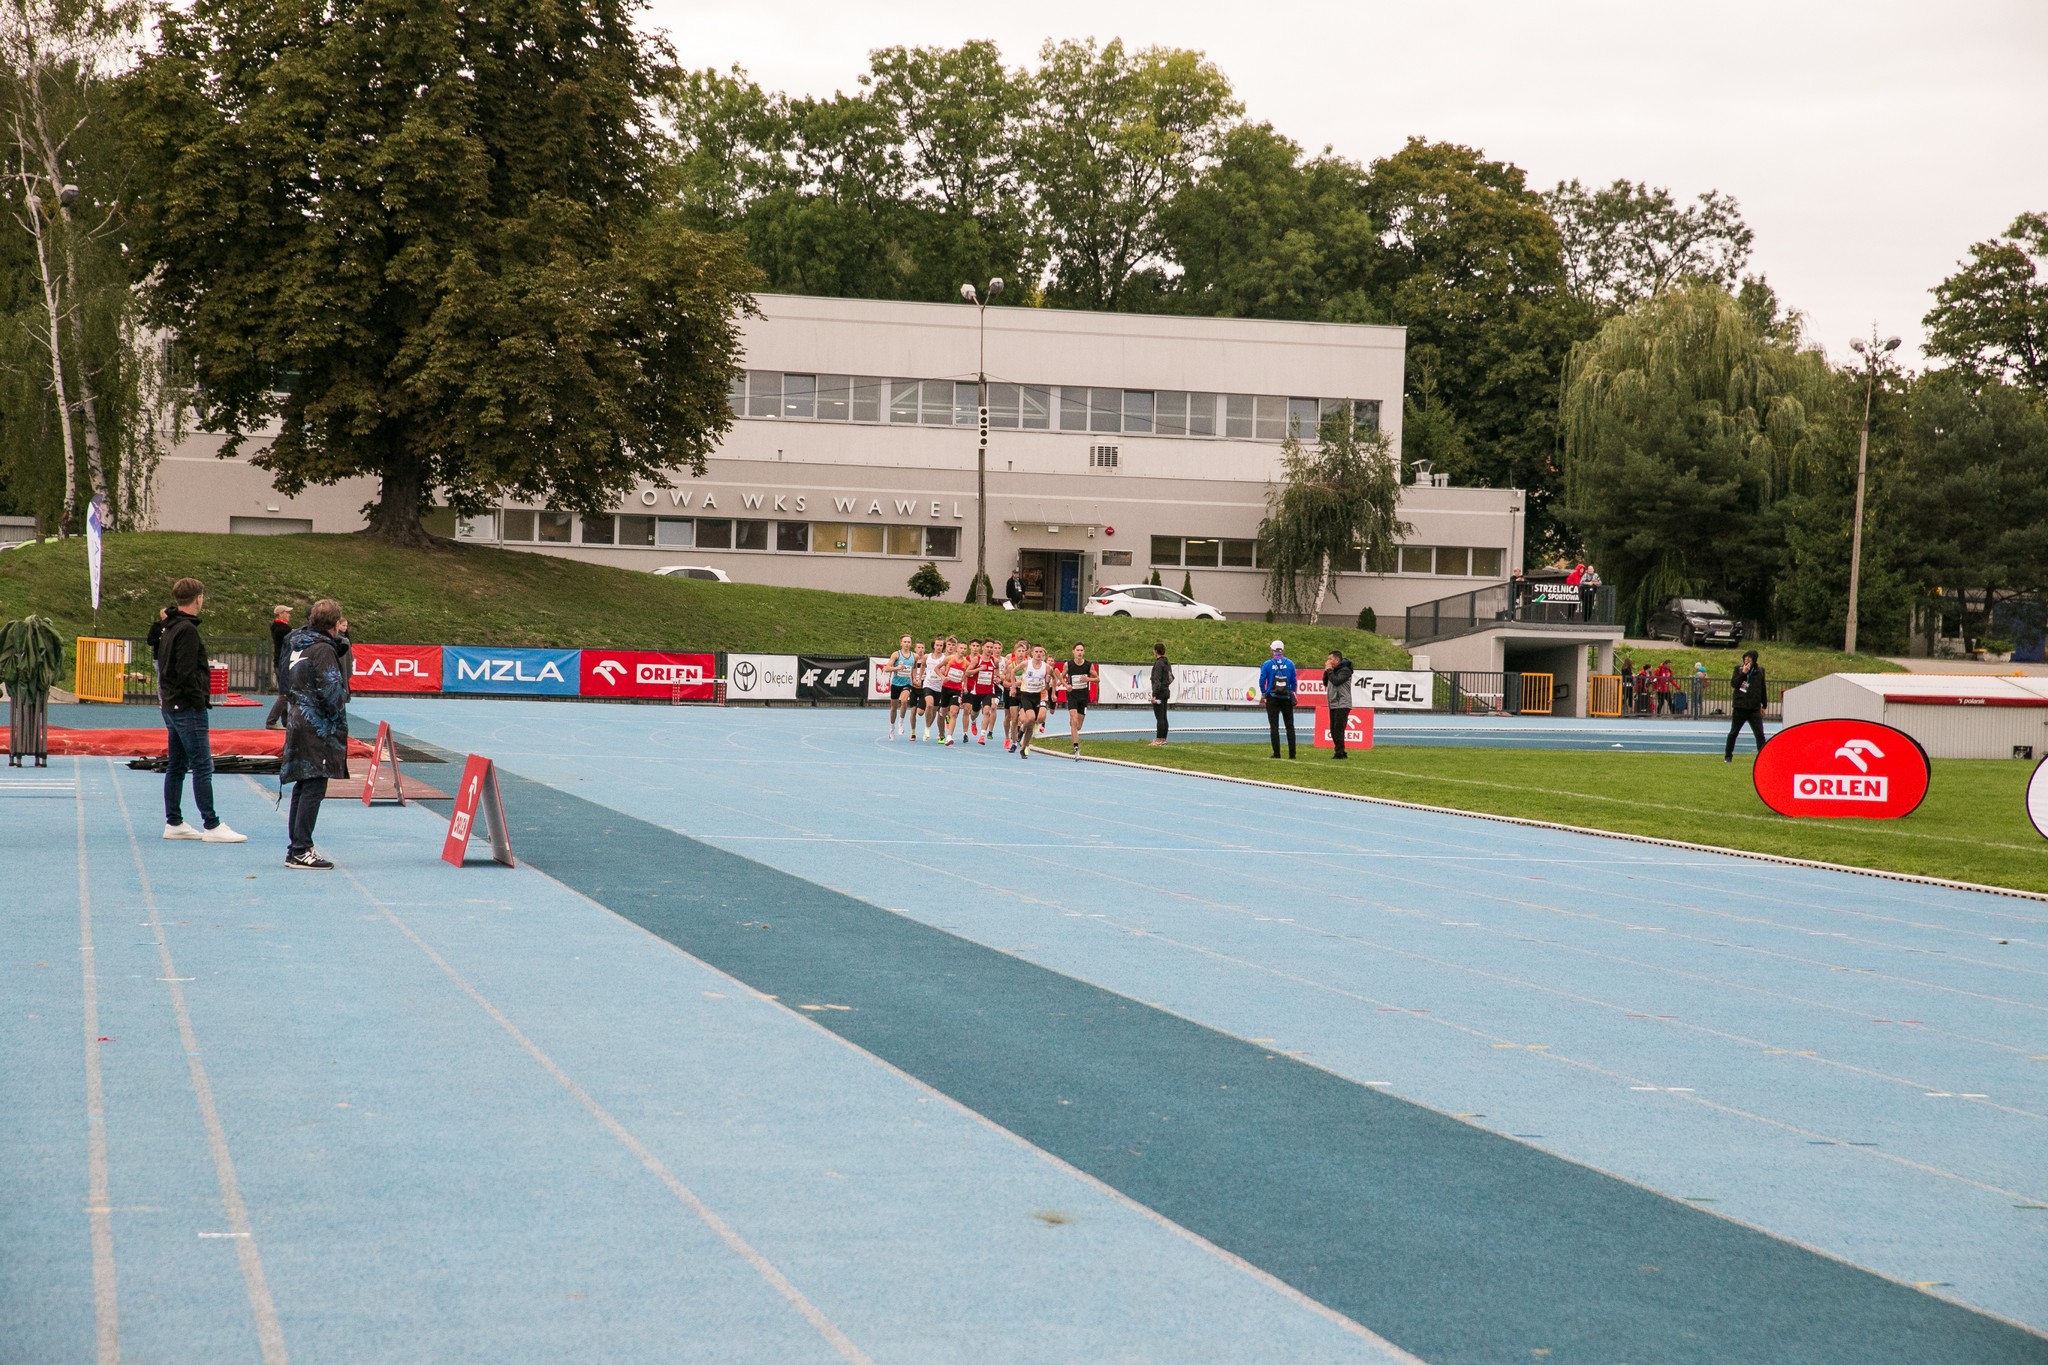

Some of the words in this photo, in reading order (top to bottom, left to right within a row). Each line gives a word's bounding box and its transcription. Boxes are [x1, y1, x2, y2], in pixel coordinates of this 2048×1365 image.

[741, 493, 806, 512] WKS
[833, 497, 963, 518] WAWEL
[1534, 584, 1579, 594] STRZELNICA
[1547, 593, 1580, 601] SPORTOWA
[352, 658, 429, 677] LA.PL
[458, 658, 565, 682] MZLA
[640, 667, 698, 681] ORLEN
[764, 671, 793, 687] Okęcie
[800, 668, 822, 687] 4F
[823, 669, 845, 687] 4F
[846, 669, 867, 687] 4F
[1182, 669, 1208, 684] NESTLÉ
[1209, 672, 1219, 684] for
[1181, 686, 1224, 700] HEALTHIER
[1226, 687, 1245, 701] KIDS
[1299, 682, 1327, 692] ORLE
[1354, 677, 1373, 689] 4F
[1372, 683, 1424, 702] FUEL
[1799, 778, 1881, 797] ORLEN
